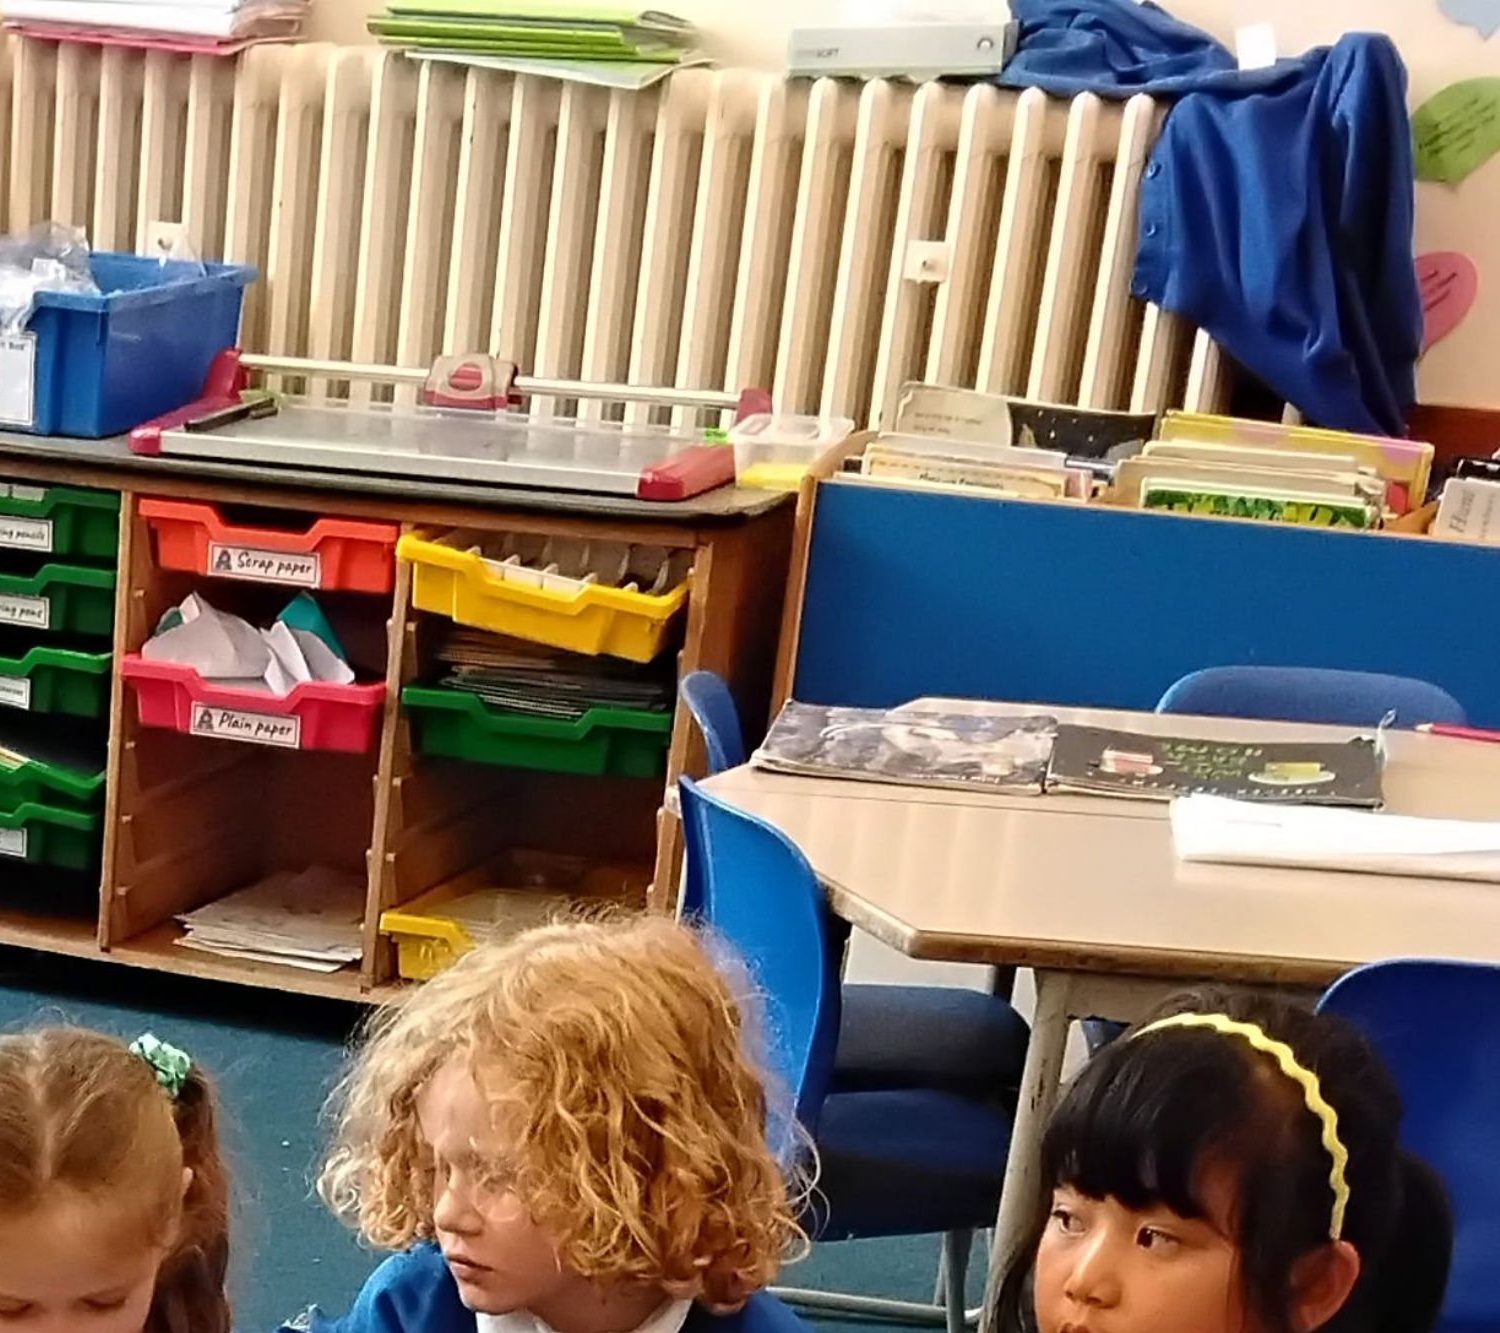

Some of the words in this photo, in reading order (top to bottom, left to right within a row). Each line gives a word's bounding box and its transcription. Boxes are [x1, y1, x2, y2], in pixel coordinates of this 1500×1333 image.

[15, 528, 45, 541] pencils
[237, 551, 275, 574] Scrap
[276, 560, 313, 577] paper
[18, 607, 43, 621] pens
[218, 711, 252, 731] Plain
[254, 720, 294, 738] paper
